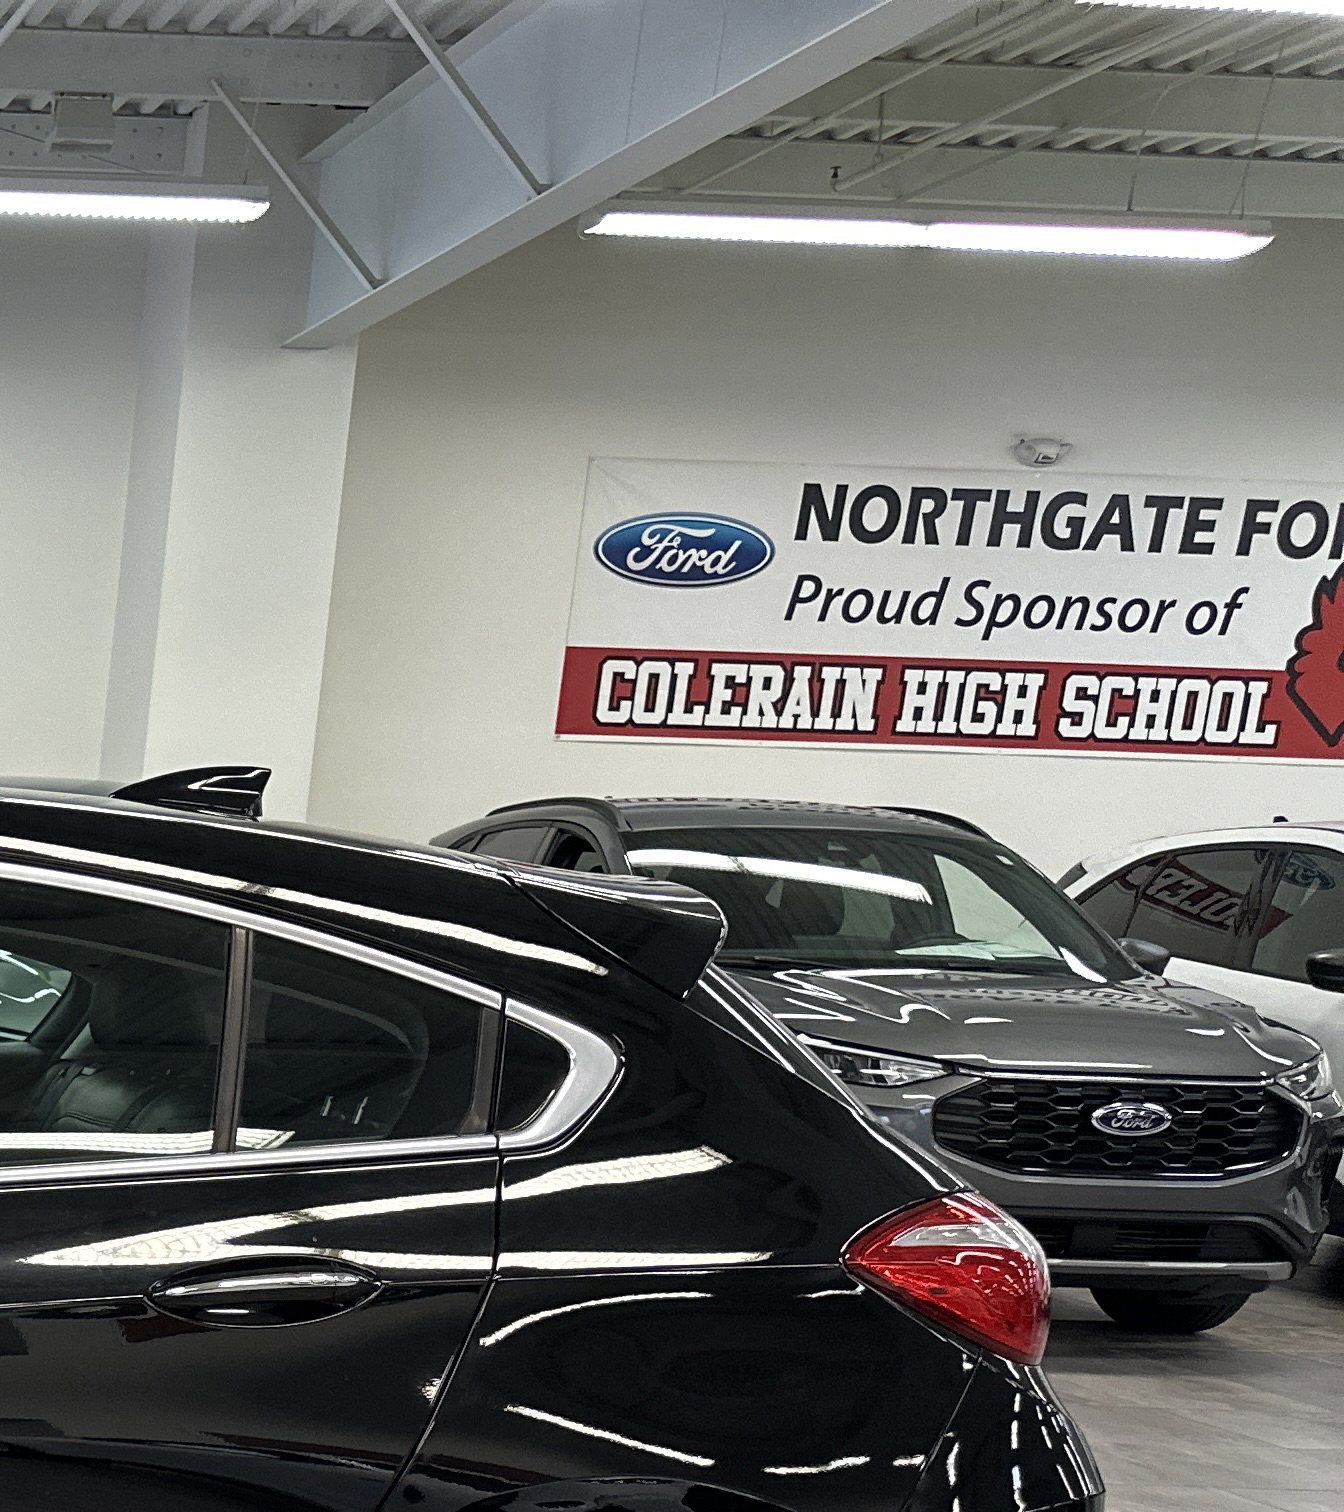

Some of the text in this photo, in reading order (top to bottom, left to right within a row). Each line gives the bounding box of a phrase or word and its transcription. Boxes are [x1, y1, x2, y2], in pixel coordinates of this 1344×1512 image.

[626, 523, 743, 575] Ford
[793, 482, 1225, 555] NORTHGATE
[783, 574, 1250, 641] Proud Sponsor of
[595, 658, 1278, 746] COLERAIN HIGH SCHOOL
[1111, 1109, 1159, 1129] Ford
